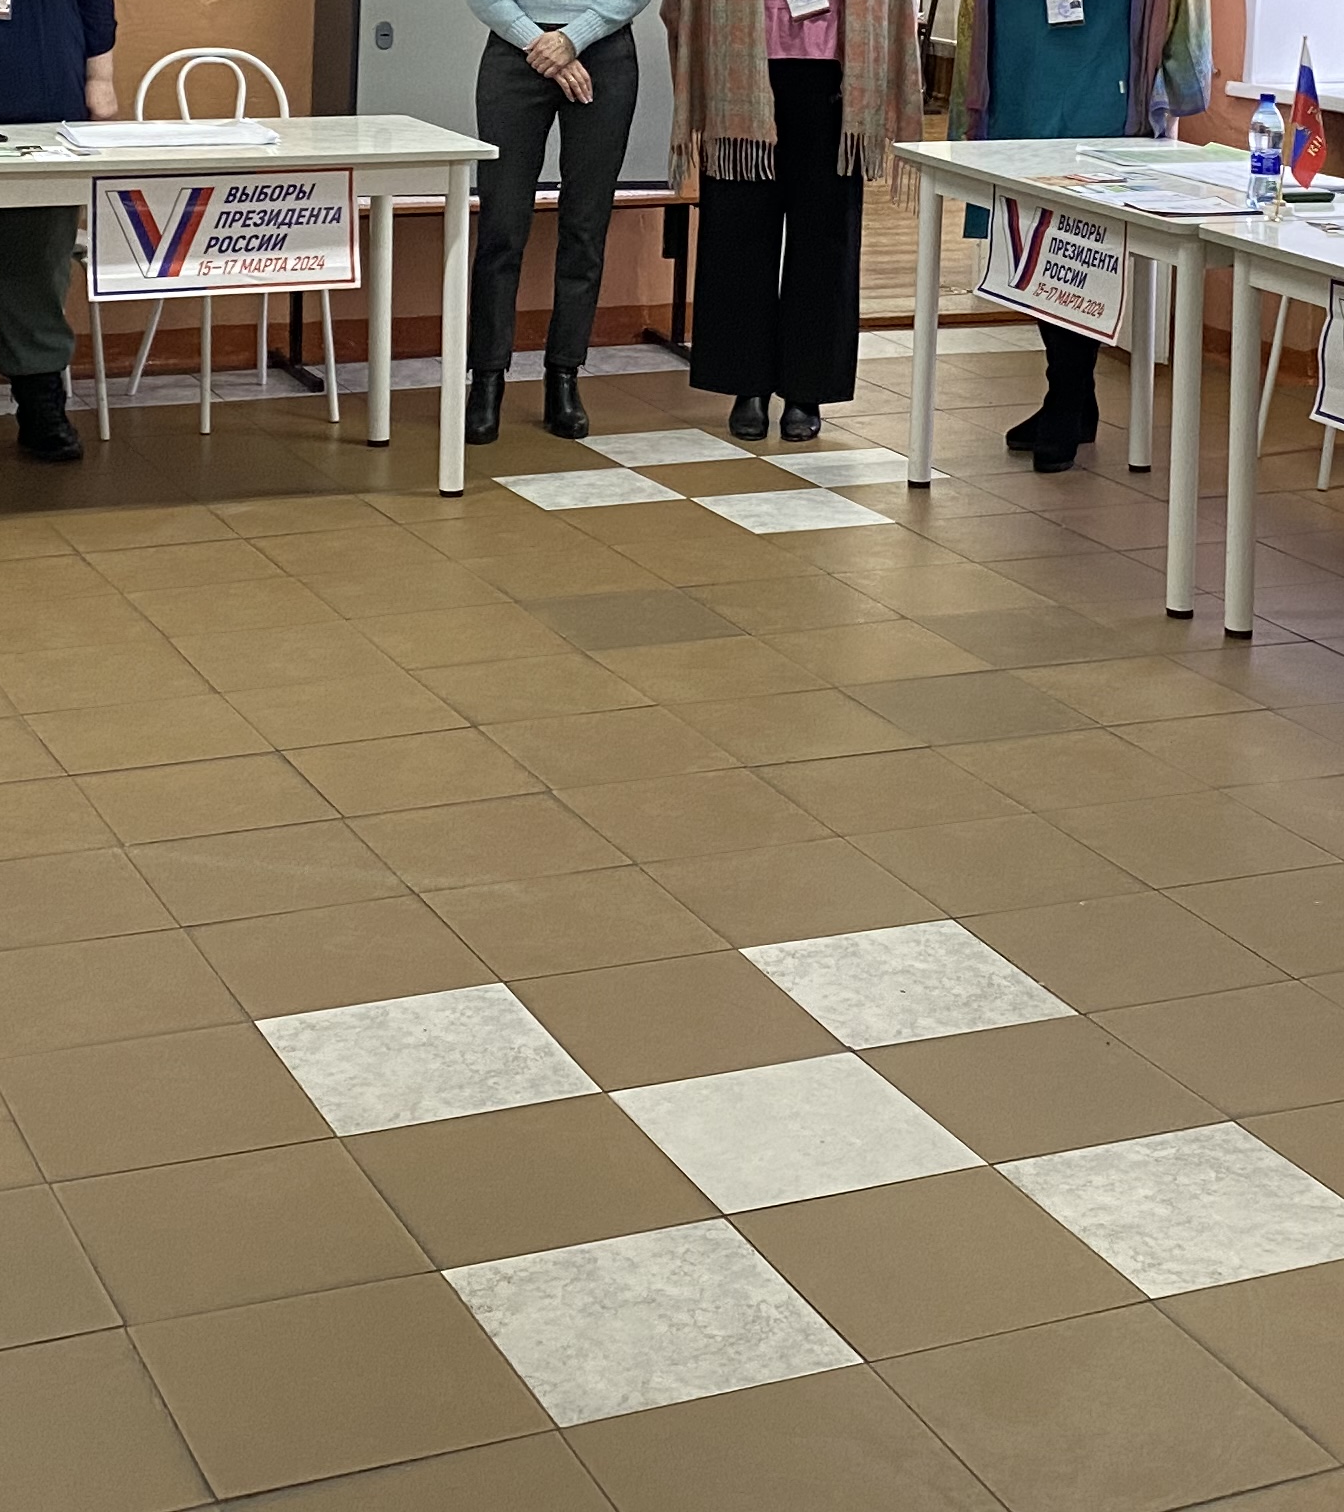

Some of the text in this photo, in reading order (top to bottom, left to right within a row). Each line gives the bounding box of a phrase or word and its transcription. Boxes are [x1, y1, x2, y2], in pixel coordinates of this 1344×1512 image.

[224, 183, 316, 204] ВЫБОРЫ
[213, 206, 343, 229] ПРЕЗИДЕНТА
[1057, 214, 1107, 244] ВЫБОРЫ
[203, 233, 288, 254] РОССИИ
[1048, 237, 1119, 274] ПРЕЗИДЕНТА
[238, 256, 289, 275] МАРТА
[290, 254, 325, 272] 2024
[1042, 260, 1088, 289] РОССИИ
[1055, 289, 1086, 310] МАРТА
[1081, 299, 1106, 318] 2024
